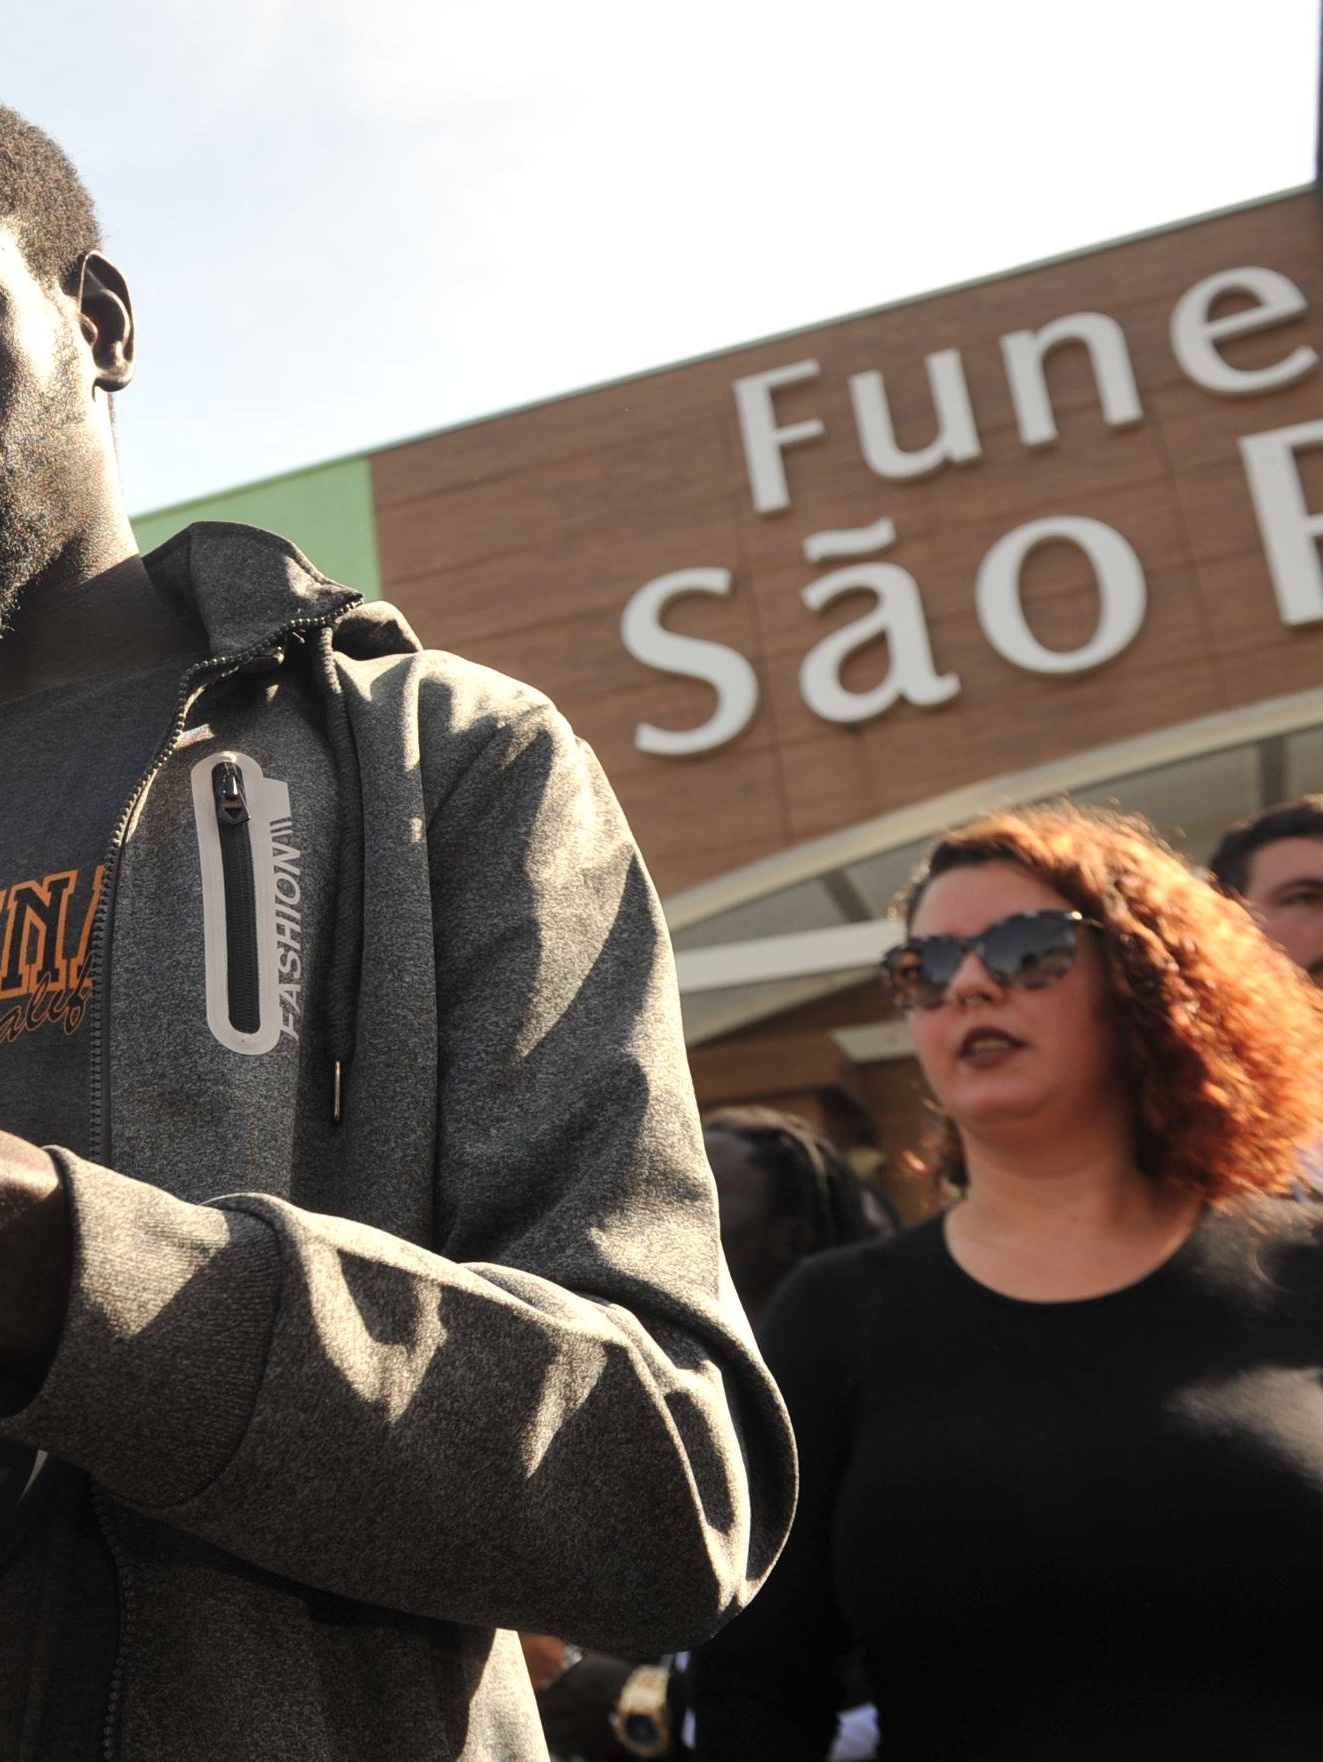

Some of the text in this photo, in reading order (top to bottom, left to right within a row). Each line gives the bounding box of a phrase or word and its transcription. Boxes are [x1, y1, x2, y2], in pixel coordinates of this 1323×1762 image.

[733, 266, 1318, 514] Fune
[620, 517, 1147, 755] São
[272, 836, 302, 1041] FASHION
